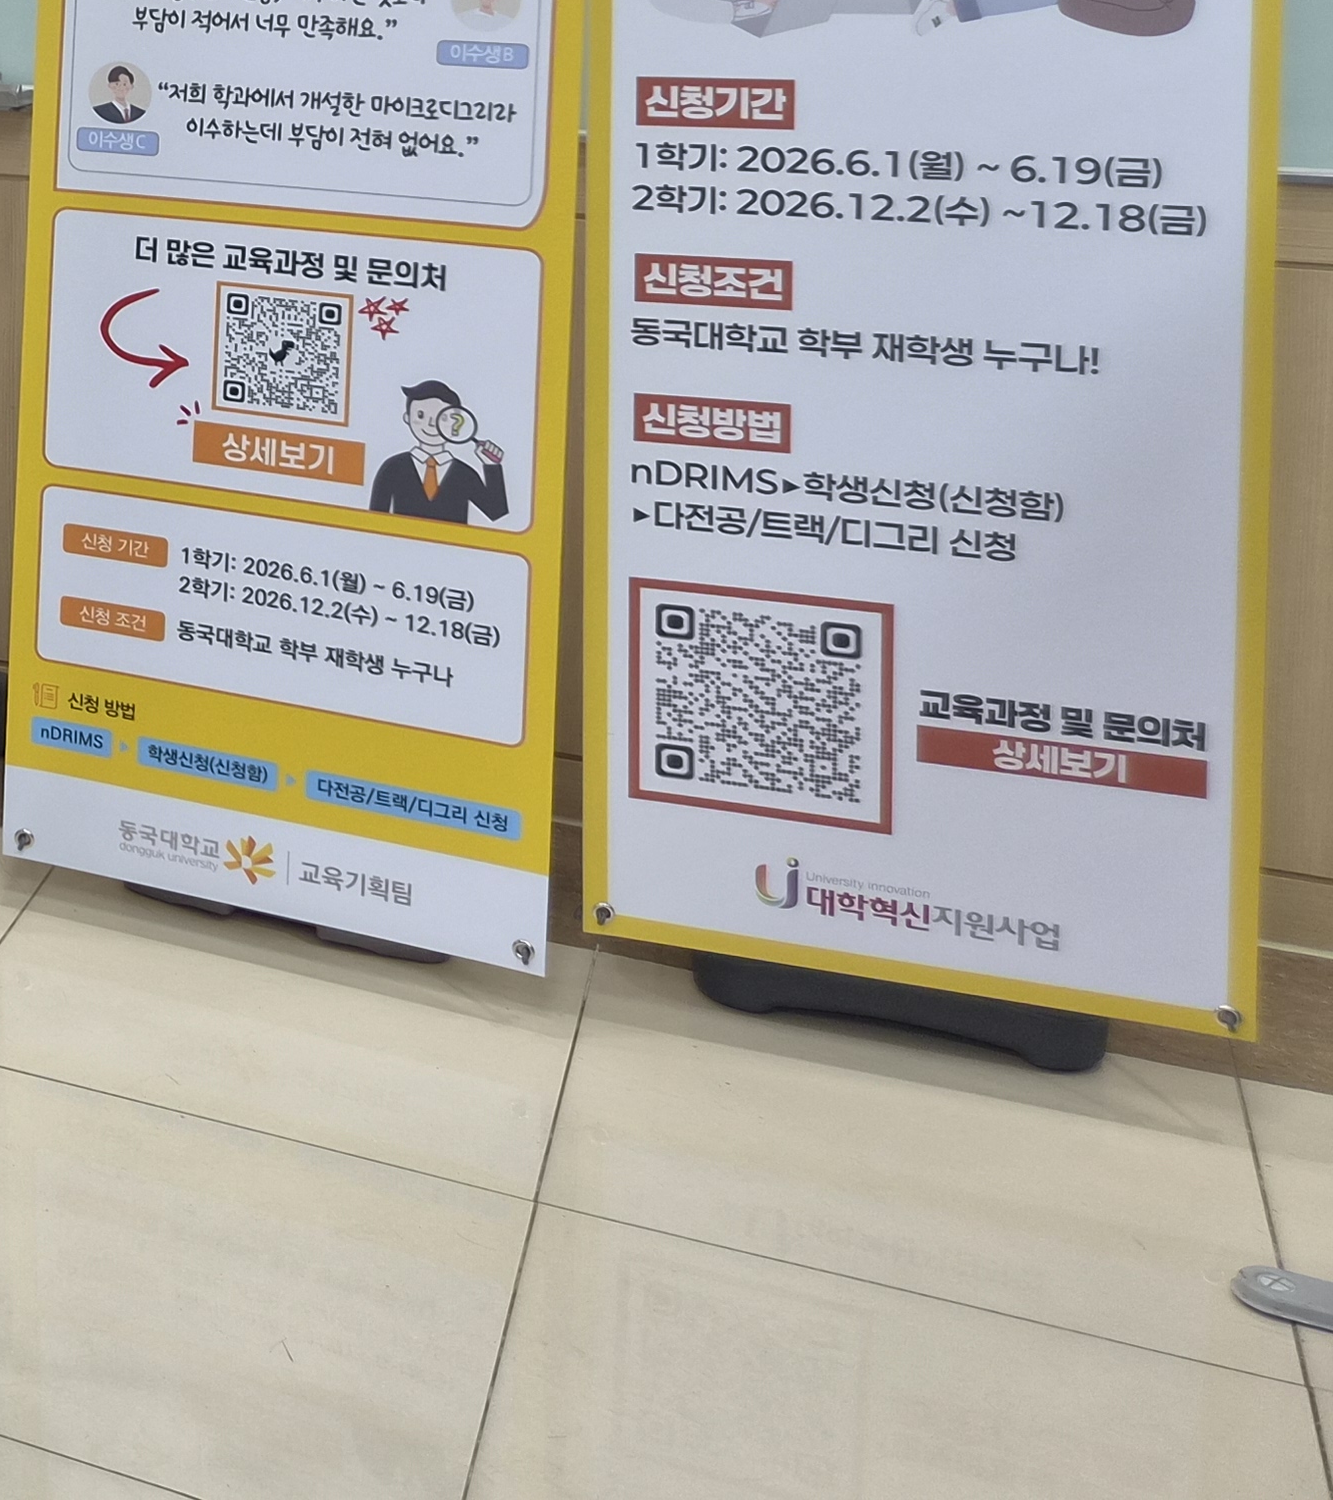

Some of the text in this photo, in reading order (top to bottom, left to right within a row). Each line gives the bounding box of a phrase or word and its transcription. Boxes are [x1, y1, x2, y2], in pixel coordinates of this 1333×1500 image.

[132, 6, 186, 34] 부담이
[191, 9, 249, 34] 적어서
[255, 13, 291, 38] 너무
[212, 83, 294, 110] 학과에서
[300, 91, 366, 118] 개설한
[370, 95, 517, 123] 마이크로디그리라
[645, 85, 787, 121] 신청기간
[186, 117, 283, 144] 이수하는데
[287, 122, 345, 151] 부담이
[349, 127, 392, 152] 전혀
[635, 141, 1162, 189] 1학기: 2026.6.1(월) 6.19(금)
[632, 184, 727, 215] 2학기:
[736, 188, 990, 227] 2026.12.2(수)
[135, 236, 446, 292] 더 많은 교육과정 및 문의처
[643, 262, 783, 301] 신청조건
[630, 317, 1099, 375] 동국대학교 학부 재학생 누구나!
[642, 402, 781, 444] 신청방법
[222, 432, 334, 475] 상세보기
[631, 460, 1064, 523] nDRIMS 학생신청(신청함)
[81, 533, 149, 558] 신청 기간
[654, 501, 1016, 562] 다전공/트랙/디그리 신청
[181, 547, 475, 613] 1학기: 2026.6.1(월) 6.19(금)
[79, 606, 146, 633] 신청 조건
[178, 576, 501, 649] 2학기: 2026.12.2(수) 12.18(금)
[177, 620, 454, 688] 동국대학교 학부 재학생 누구나
[67, 692, 136, 721] 신청 방법
[919, 689, 1206, 752] 교육과정 및 문의처
[40, 725, 508, 833] nDRIMS 학생신청(신청함) 다전공/트랙/디그리 신청
[992, 739, 1127, 784] 상세보기
[118, 820, 220, 859] 동국대학교
[298, 861, 412, 907] 교육기획팀
[806, 886, 1060, 951] 대학혁신지원사업
